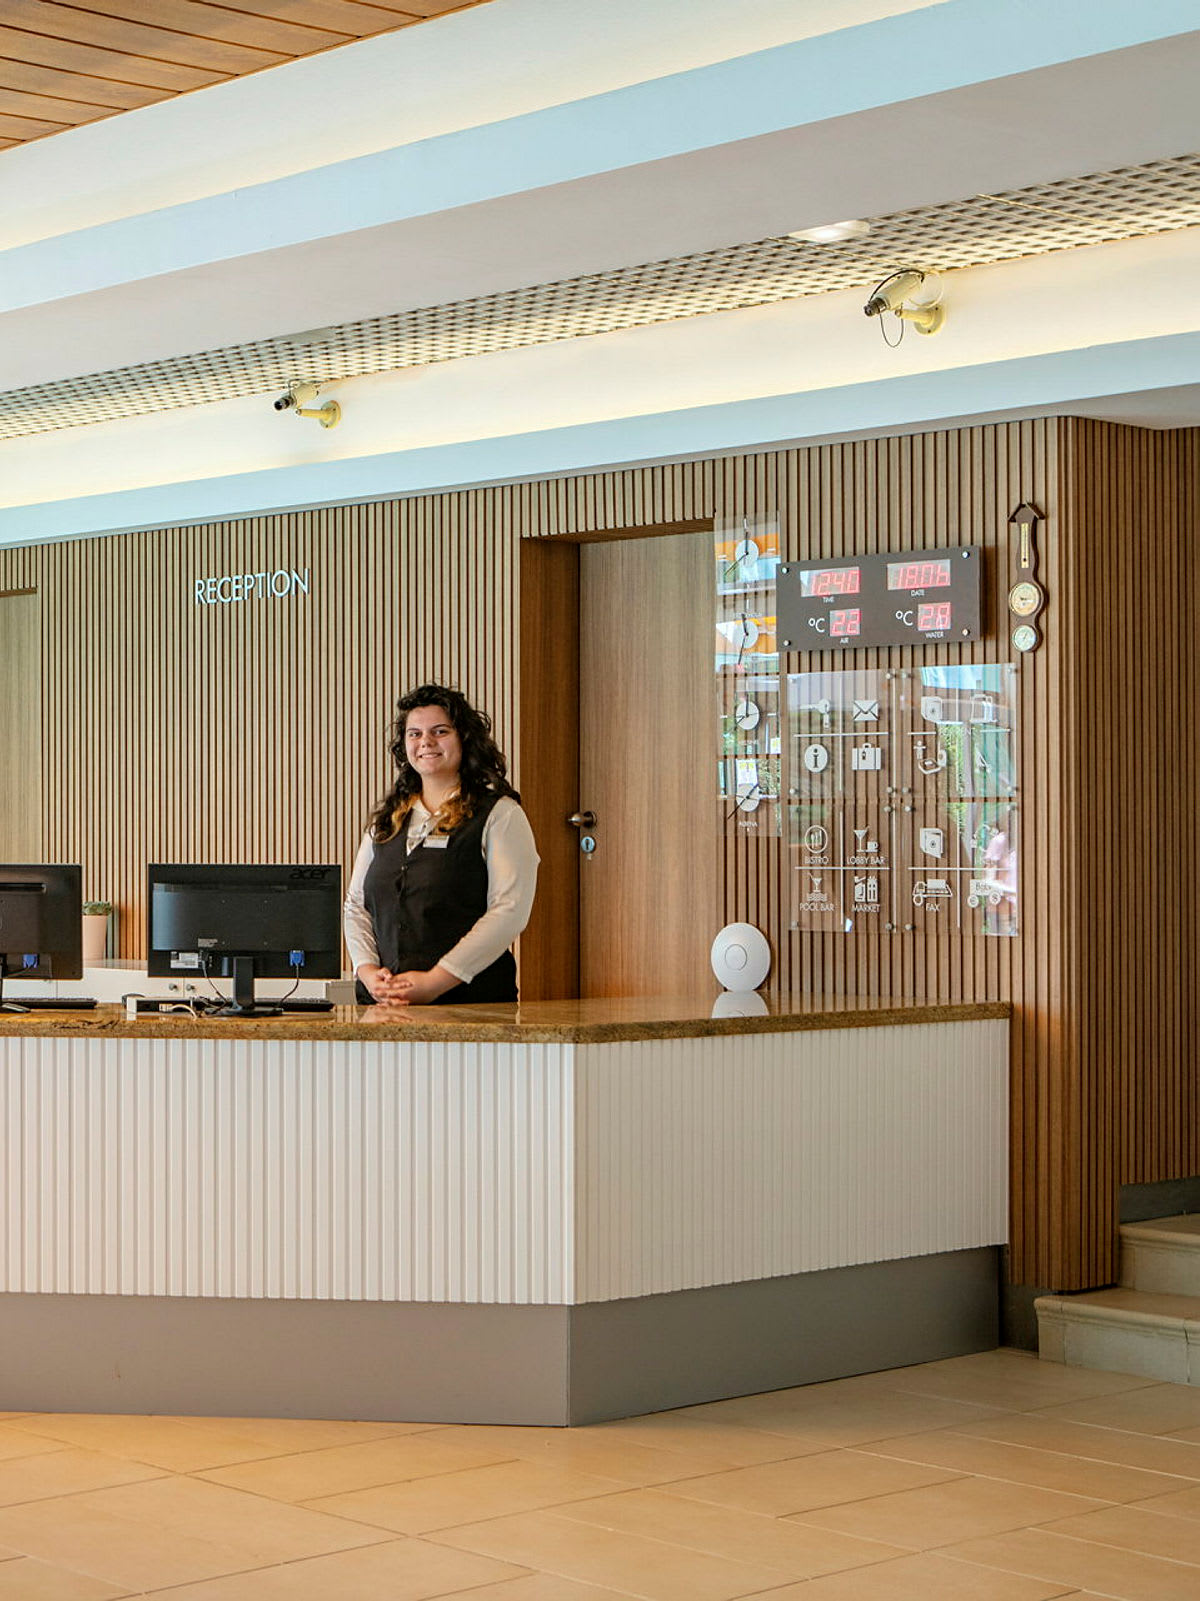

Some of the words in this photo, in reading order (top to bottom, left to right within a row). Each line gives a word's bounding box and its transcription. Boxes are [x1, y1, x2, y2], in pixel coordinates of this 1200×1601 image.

[195, 568, 310, 605] RECEPTION
[911, 589, 925, 597] DATE
[822, 596, 835, 604] TIME
[831, 610, 861, 634] 22
[920, 604, 950, 630] 28
[925, 631, 944, 639] WATER
[805, 856, 830, 865] BISTRO
[847, 856, 870, 865] LOBBY
[871, 856, 886, 865] BAR
[289, 867, 331, 880] acer
[799, 902, 820, 912] POOL
[820, 903, 835, 912] BAR
[852, 903, 881, 913] MARKET
[925, 902, 940, 912] FAX
